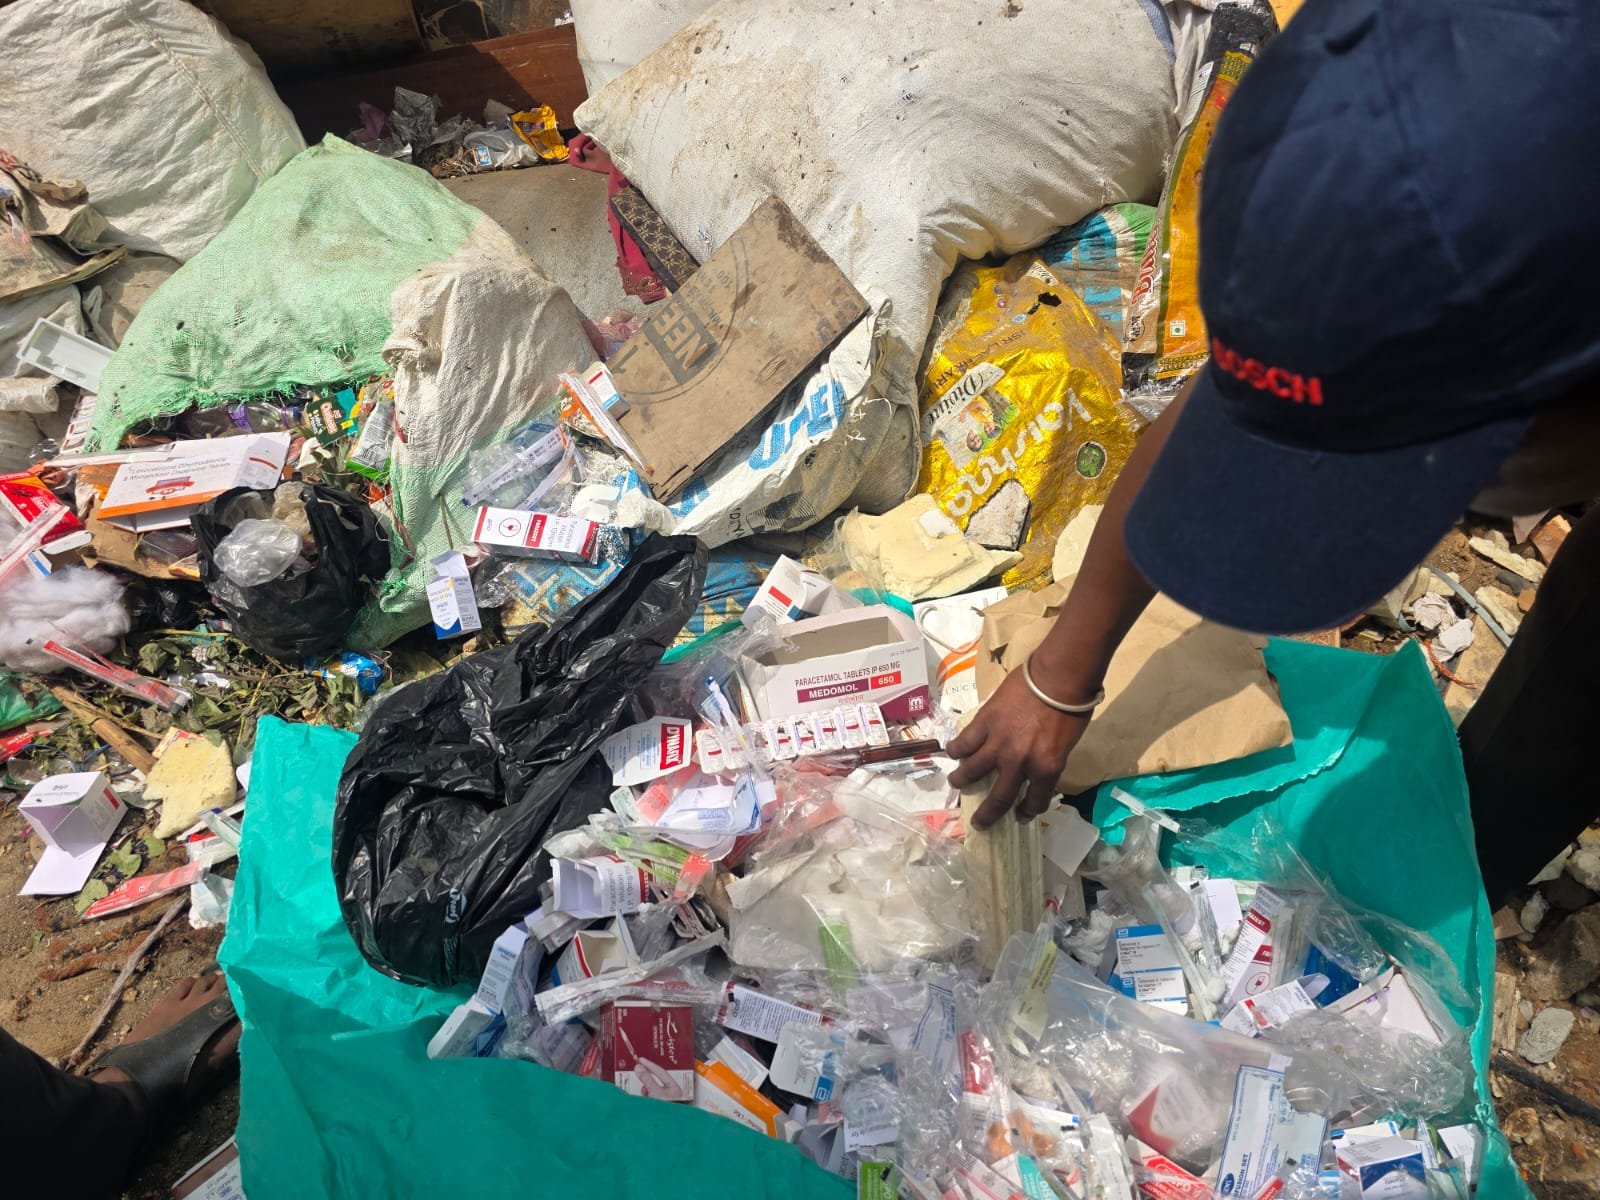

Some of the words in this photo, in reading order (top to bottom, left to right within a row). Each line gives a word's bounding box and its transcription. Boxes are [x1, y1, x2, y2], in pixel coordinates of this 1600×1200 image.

[795, 673, 842, 688] PARACETAMOL
[843, 667, 871, 680] TABLETS
[878, 663, 889, 673] 650
[890, 660, 901, 670] MG
[808, 683, 859, 700] MEDOMOL
[878, 675, 895, 685] 650
